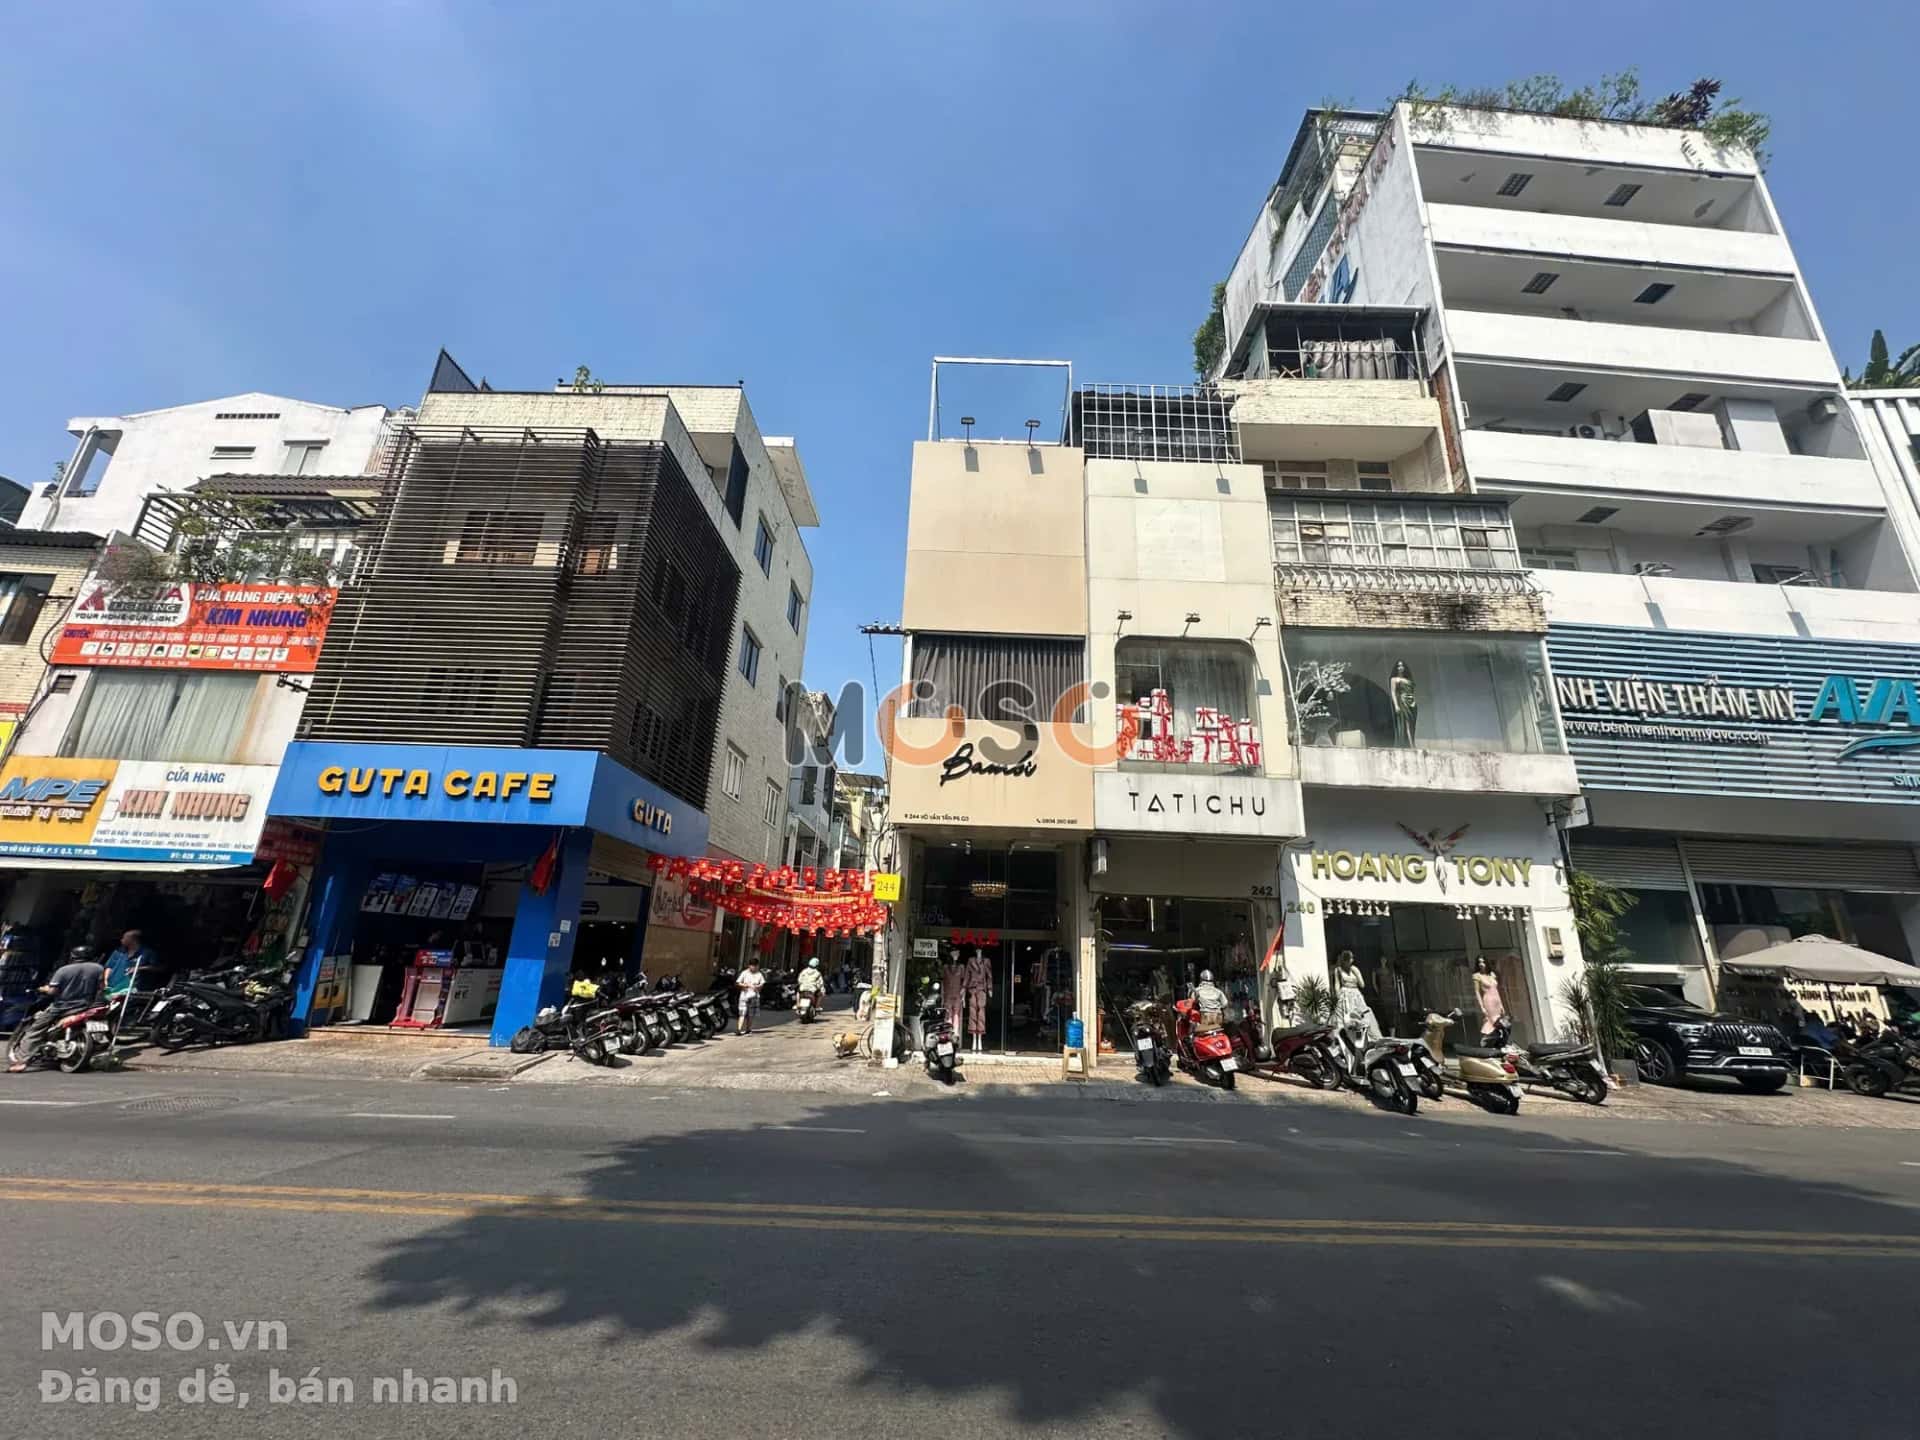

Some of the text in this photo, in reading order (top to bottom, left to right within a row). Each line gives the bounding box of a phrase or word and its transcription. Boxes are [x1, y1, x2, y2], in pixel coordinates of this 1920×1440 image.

[223, 588, 261, 602] HÀNG
[75, 612, 98, 620] YOUR
[205, 608, 308, 628] KIM NHUNG
[1604, 674, 1669, 720] VIỆN
[1672, 673, 1751, 718] THẨM
[1757, 683, 1797, 721] MỸ
[1808, 675, 1920, 726] AVA
[166, 766, 226, 783] CỬA HÀNG
[318, 767, 554, 799] GUTA CAFE
[0, 776, 108, 804] MPE
[119, 790, 251, 820] KIM NHUNG
[1128, 792, 1265, 816] TATICHU
[632, 799, 673, 836] GUTA
[1310, 850, 1533, 887] HOANG TONY
[877, 881, 896, 893] 244
[1251, 886, 1273, 896] 242
[1287, 902, 1315, 914] 240
[951, 929, 999, 945] SALE
